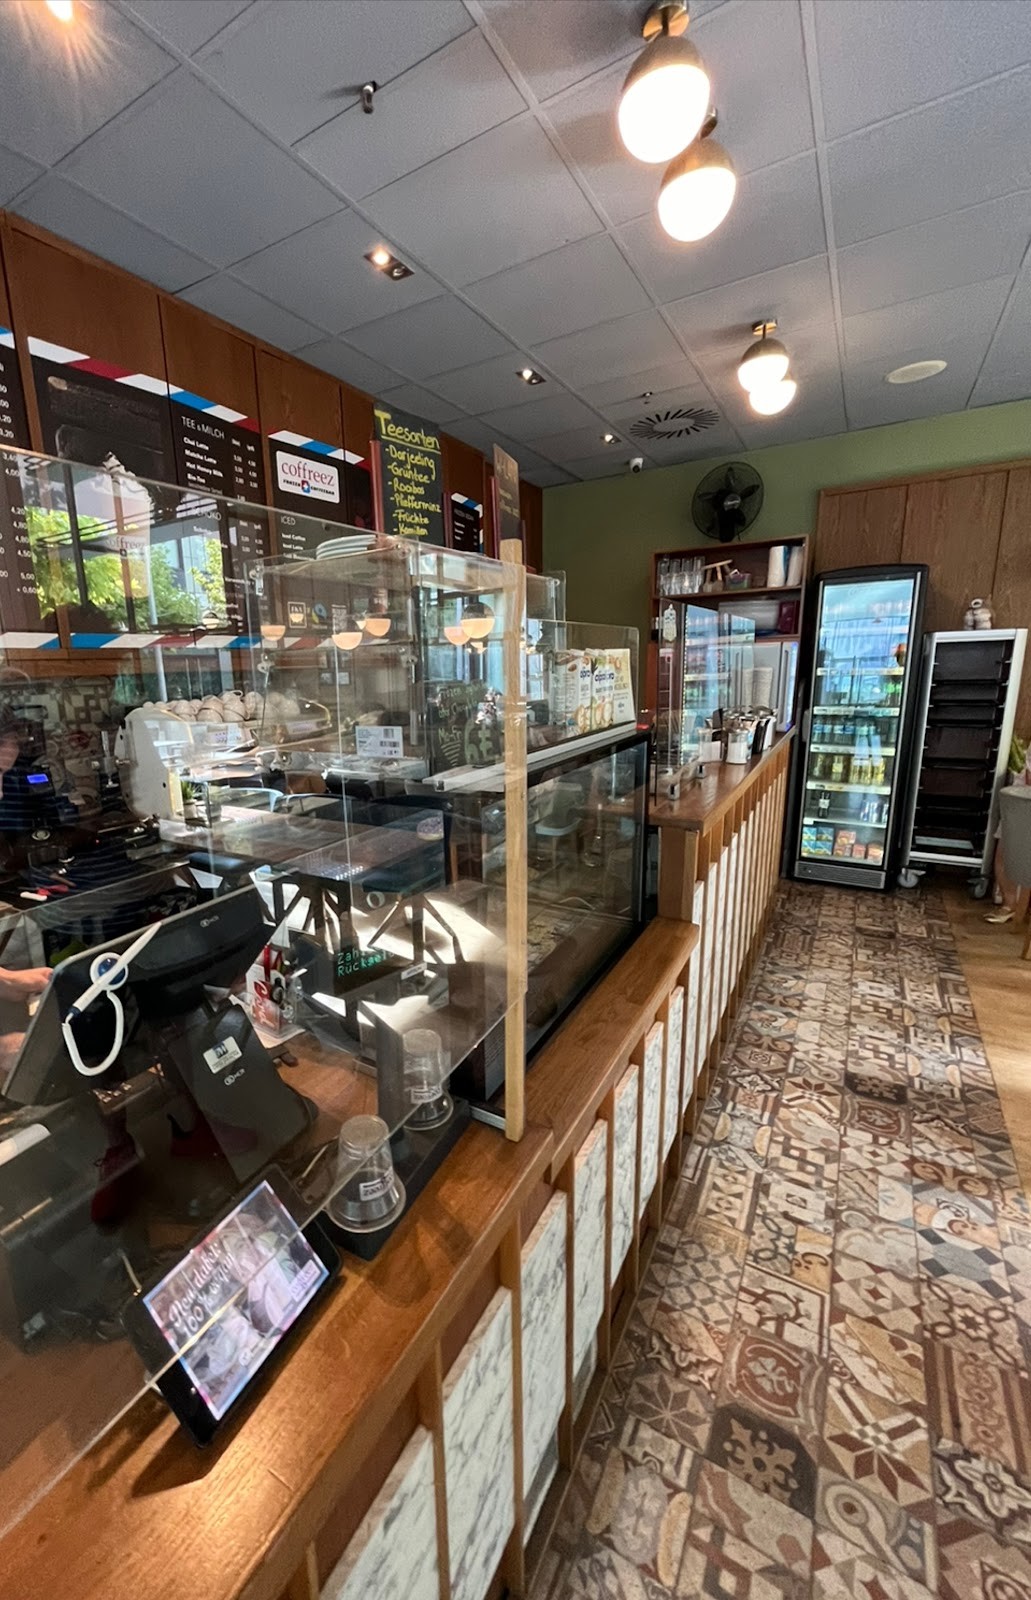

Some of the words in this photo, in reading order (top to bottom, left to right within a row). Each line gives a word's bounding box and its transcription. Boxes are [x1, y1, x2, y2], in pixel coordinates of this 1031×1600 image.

[181, 416, 196, 430] TEE
[201, 424, 225, 439] MILCH
[374, 409, 441, 450] Teesorten
[281, 461, 336, 487] coffreez
[280, 515, 296, 526] ICED
